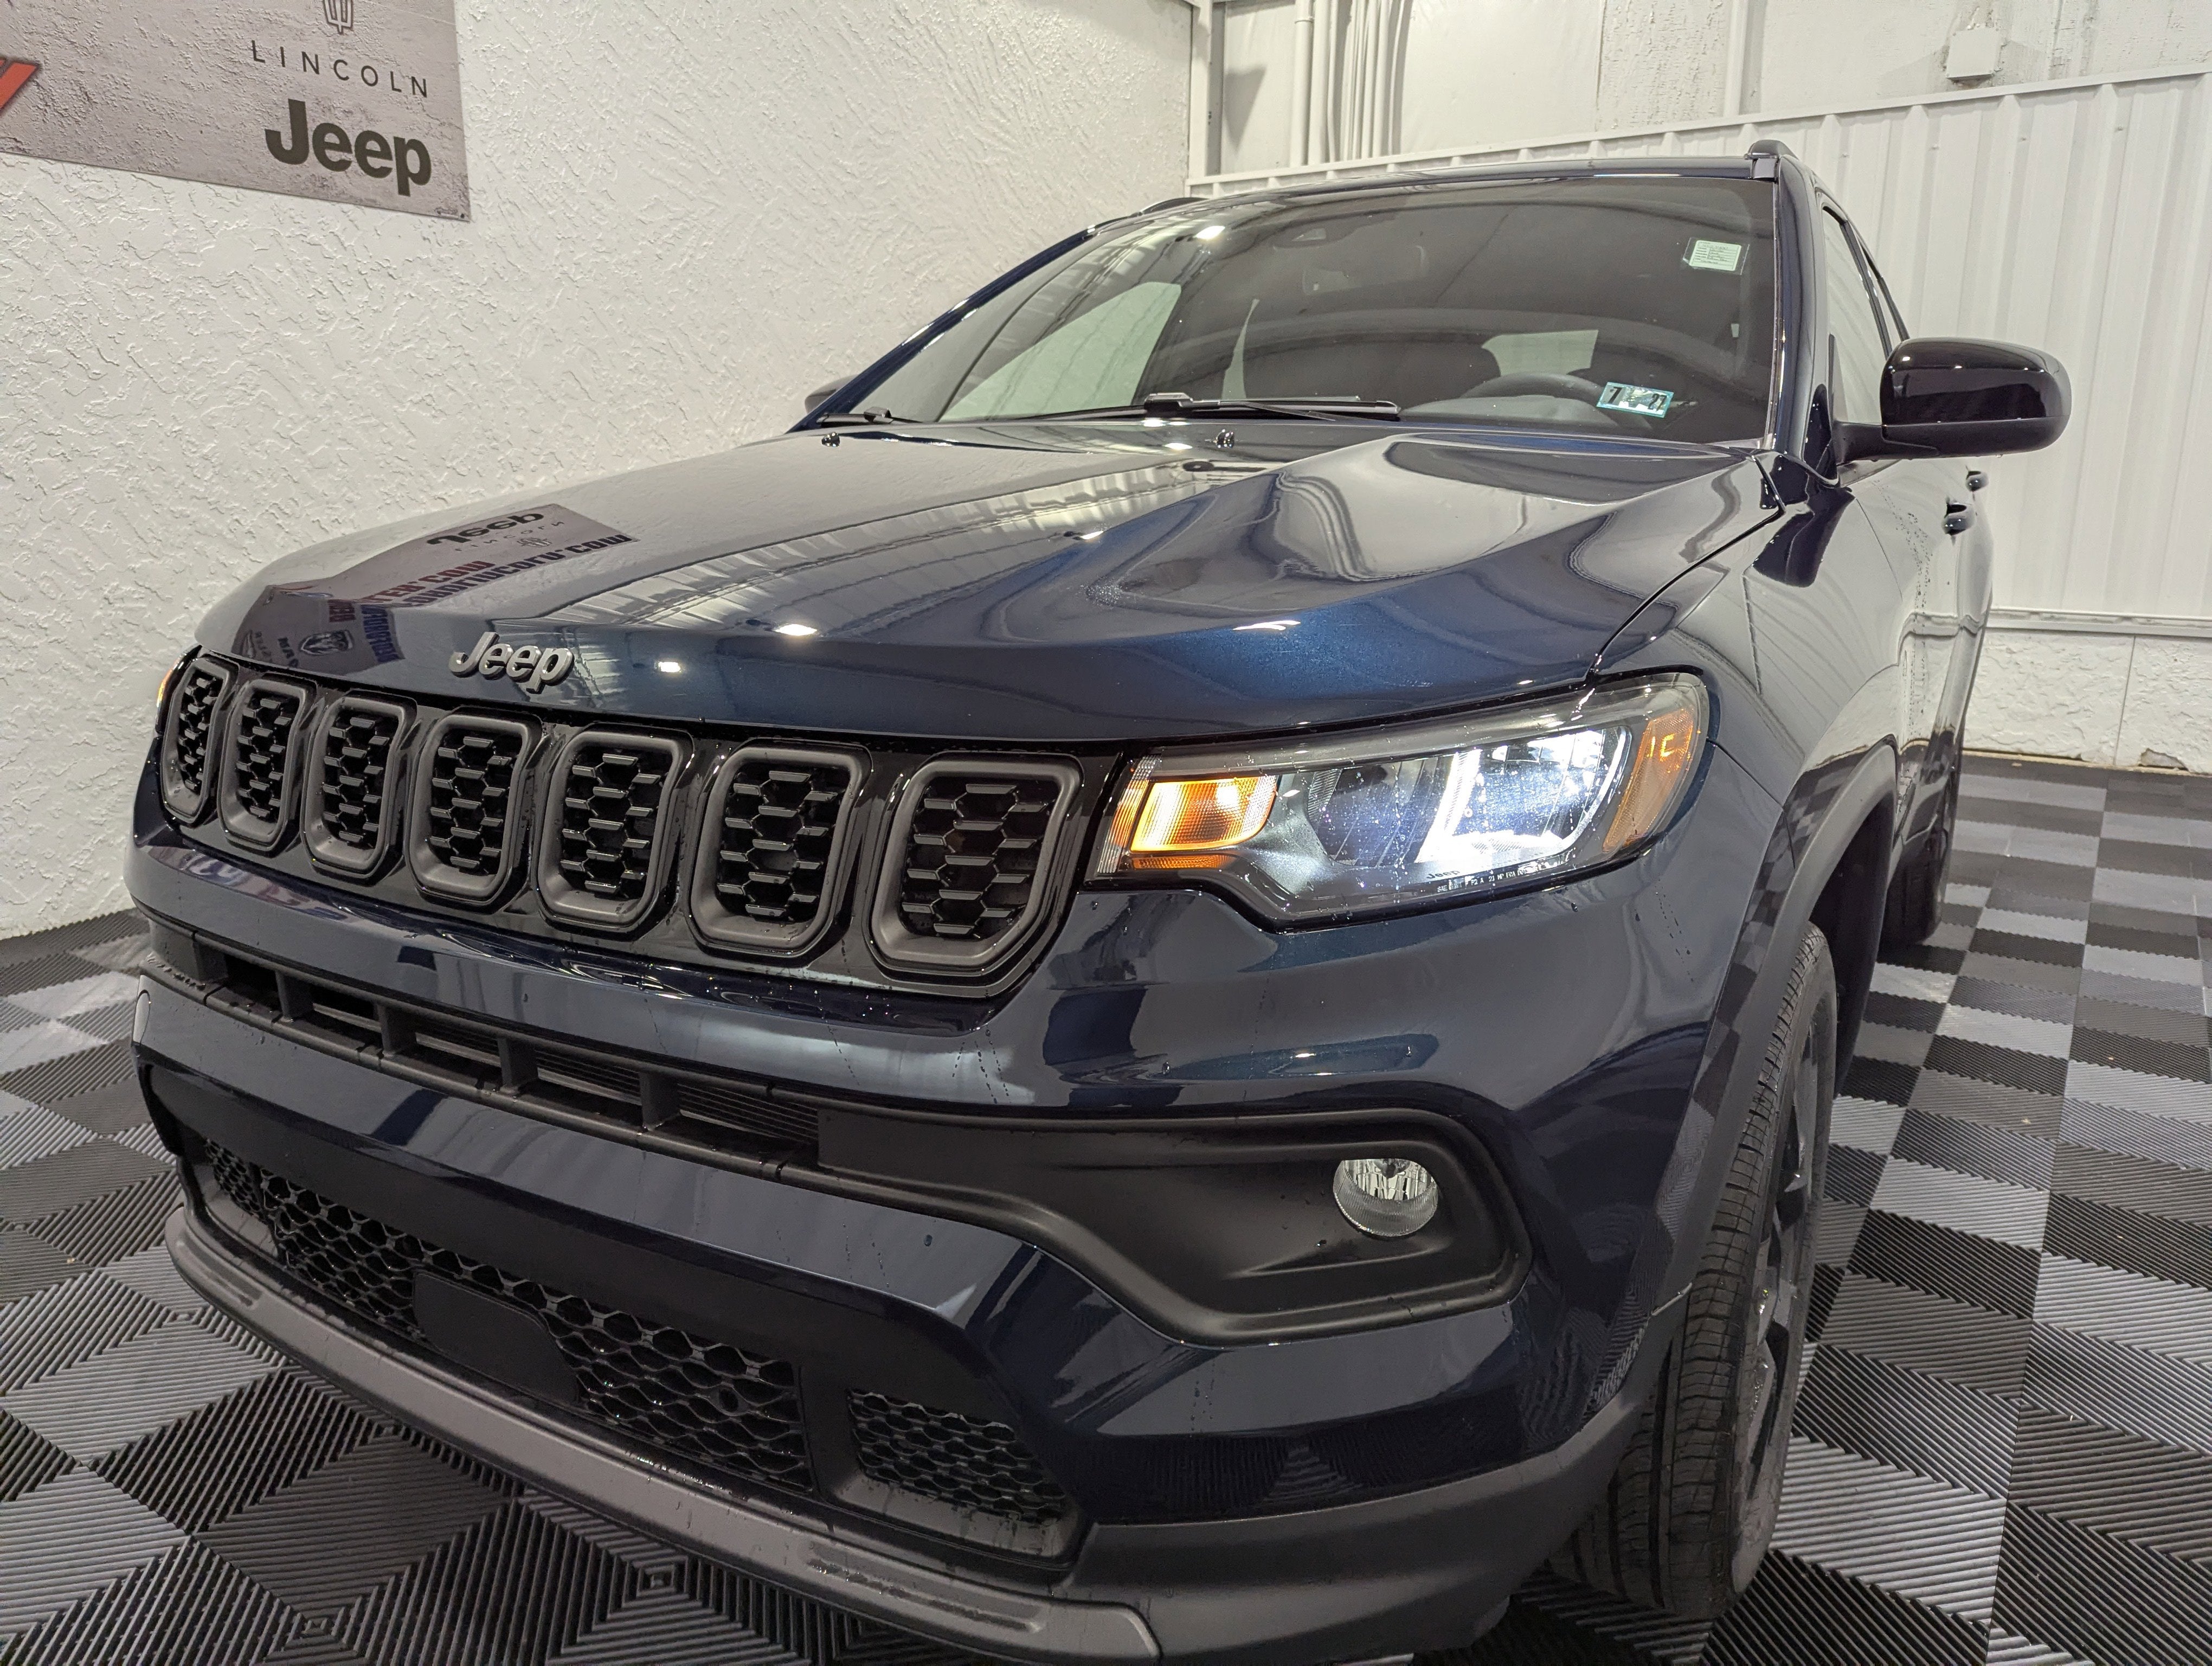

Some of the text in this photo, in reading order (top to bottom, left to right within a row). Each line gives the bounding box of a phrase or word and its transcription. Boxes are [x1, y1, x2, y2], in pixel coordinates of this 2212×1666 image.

[252, 40, 428, 98] LINCOLN
[264, 98, 432, 197] Jeep
[1647, 393, 1668, 412] 27
[448, 631, 574, 694] Jeep
[1426, 870, 1461, 879] Jeep
